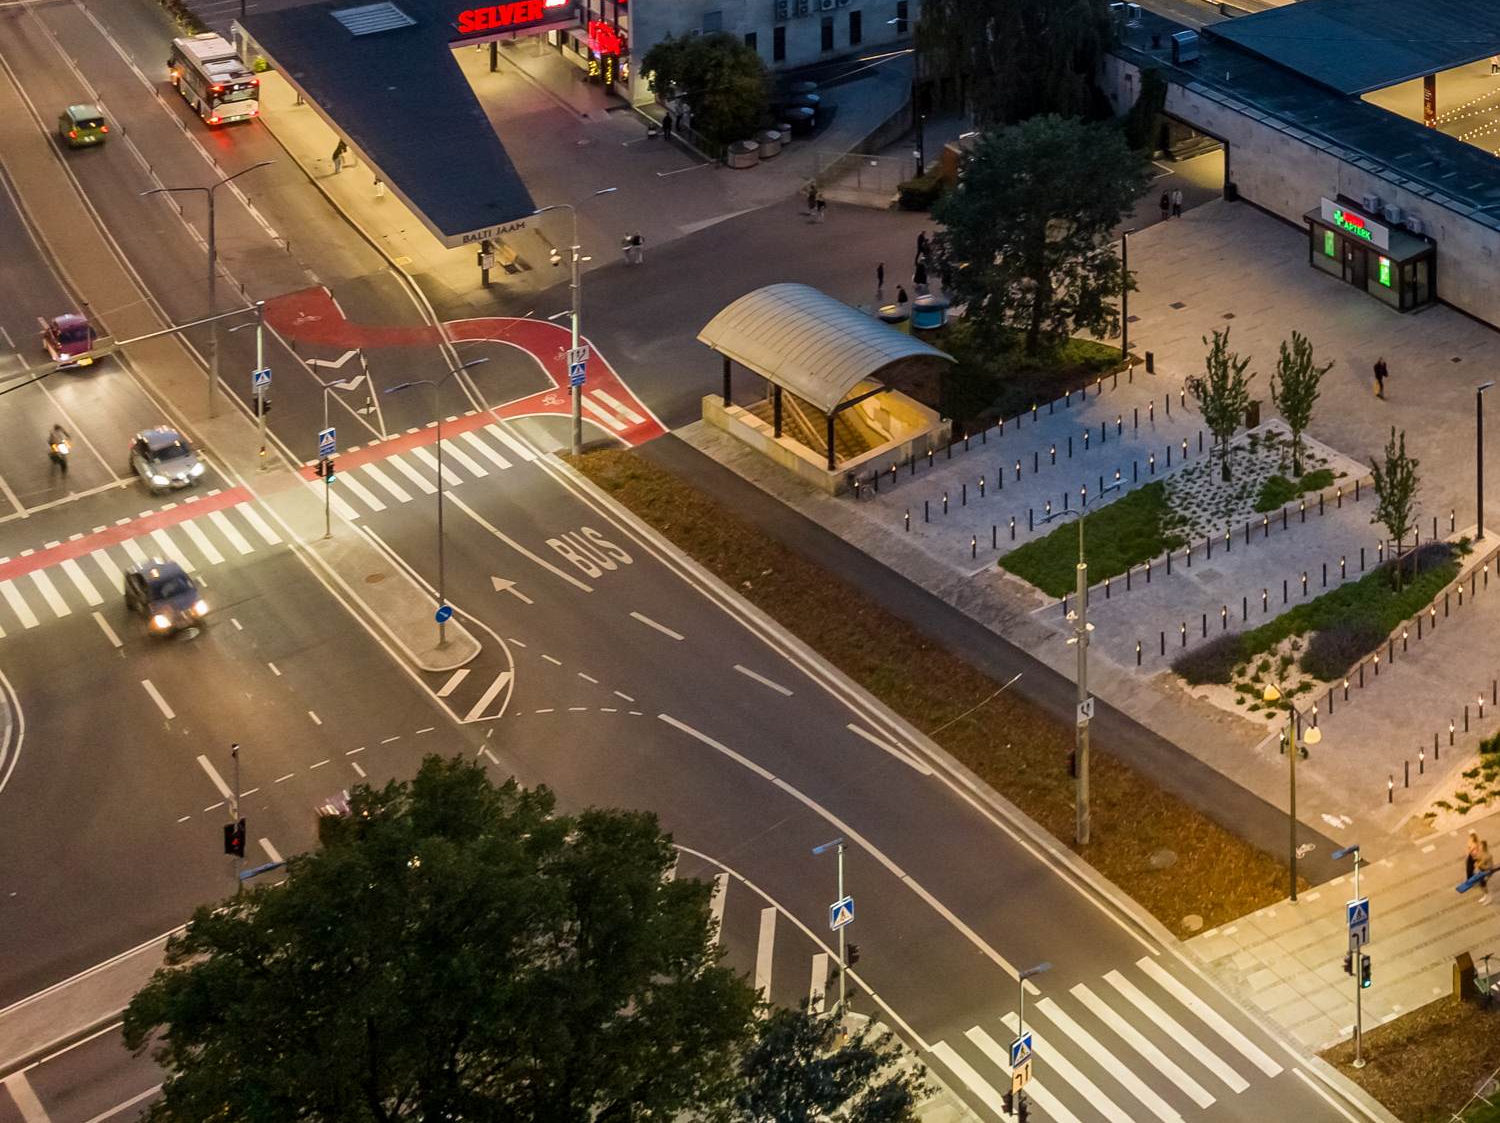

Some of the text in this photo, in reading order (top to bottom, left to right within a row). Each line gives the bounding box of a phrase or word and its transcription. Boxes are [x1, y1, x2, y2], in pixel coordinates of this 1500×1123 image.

[463, 221, 526, 244] BALTI JAAM
[545, 526, 633, 578] BUS
